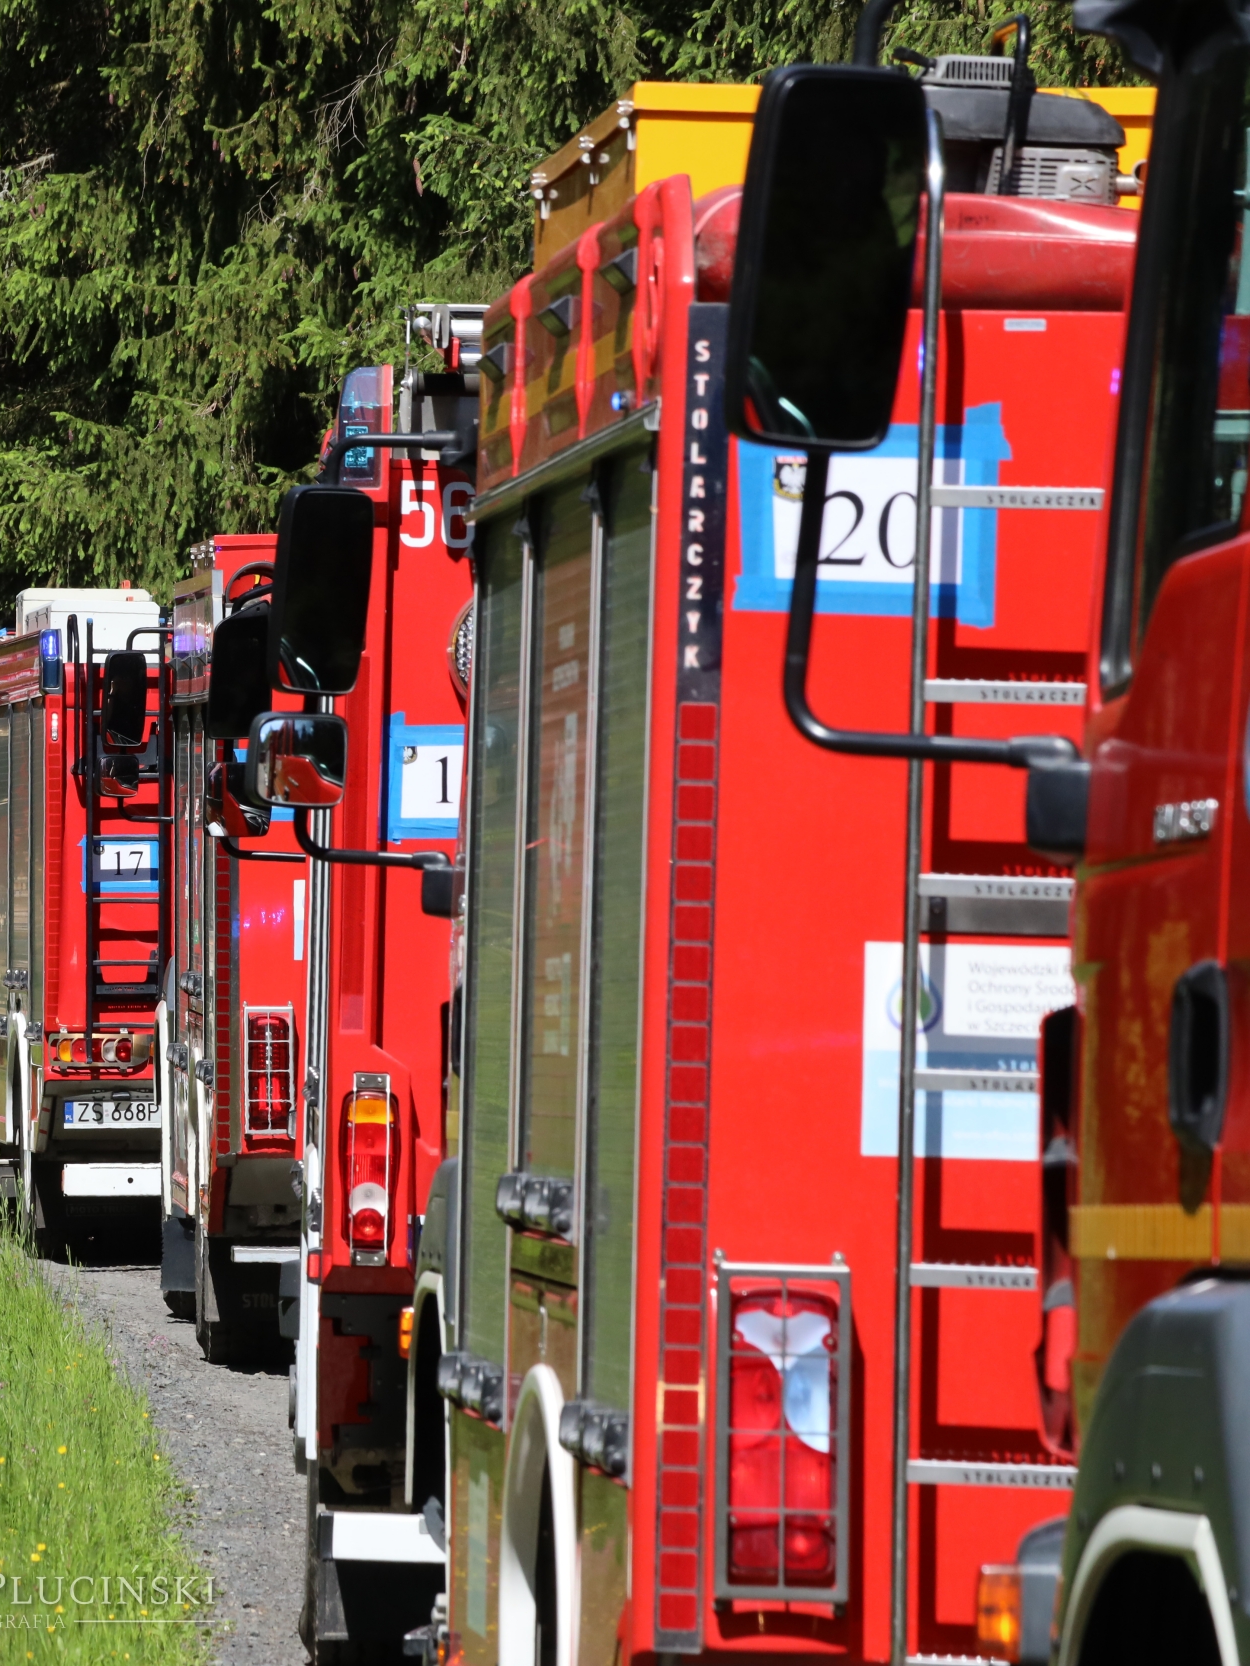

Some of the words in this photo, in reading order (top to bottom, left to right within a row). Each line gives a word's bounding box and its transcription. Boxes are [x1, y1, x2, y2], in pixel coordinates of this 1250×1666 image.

[684, 340, 711, 669] STOLARCZYK
[986, 494, 1098, 507] STOLARCZYK
[818, 490, 920, 569] 20
[114, 850, 144, 876] 17
[78, 1102, 104, 1122] ZS
